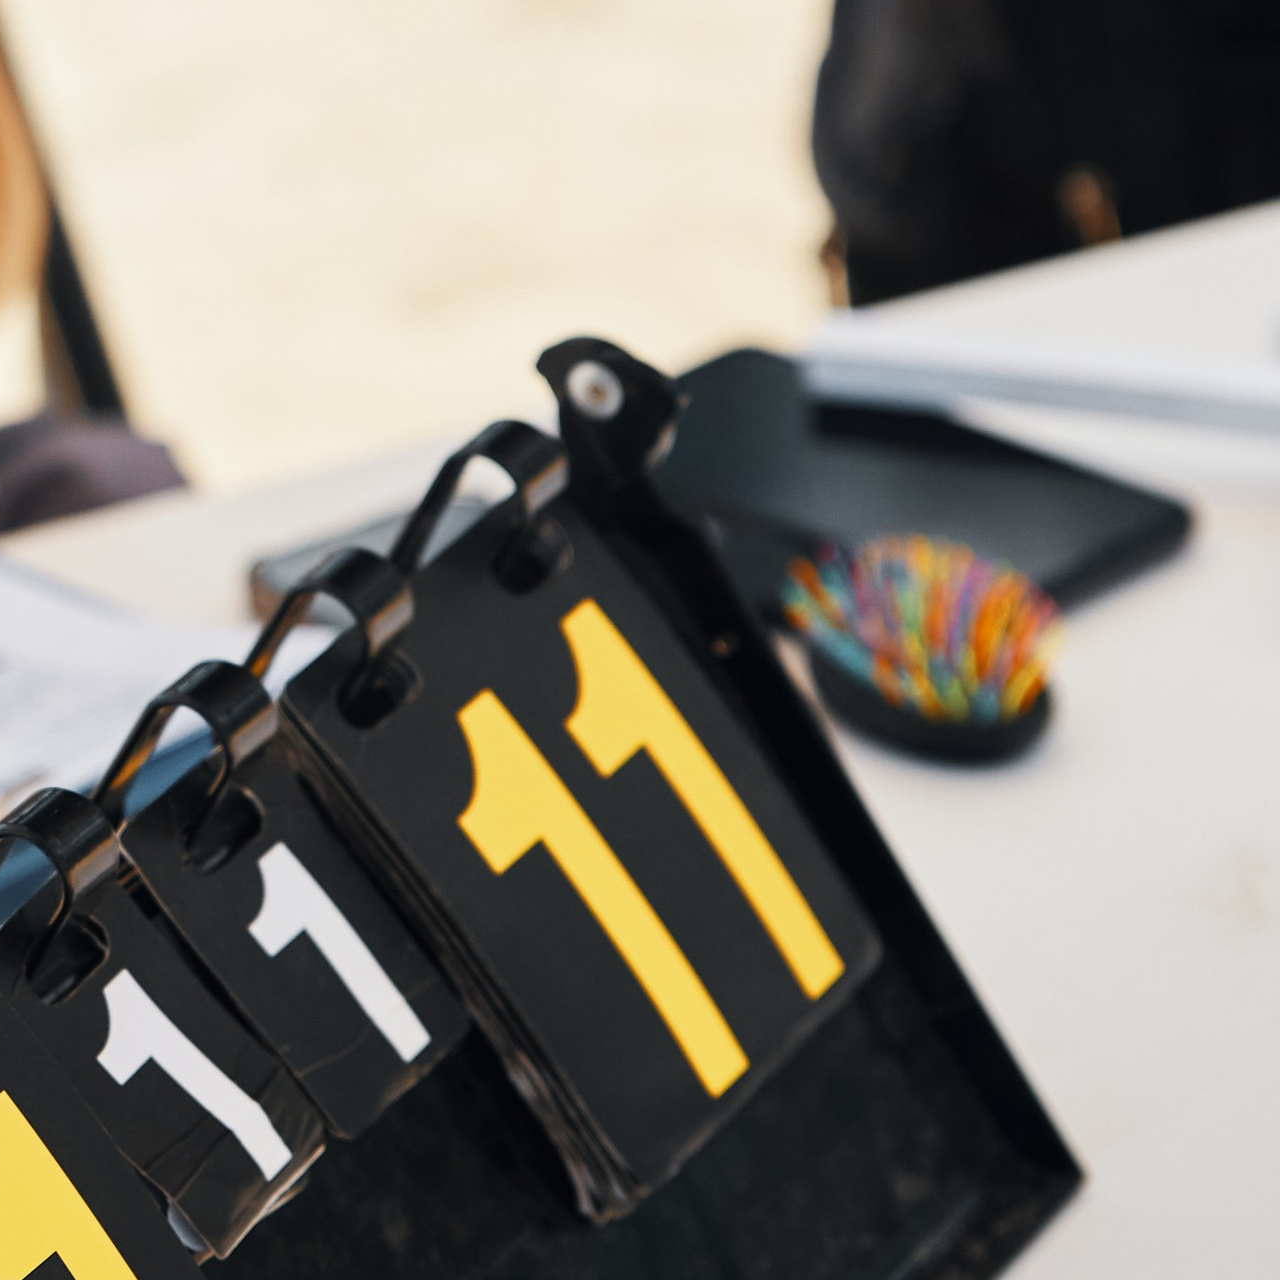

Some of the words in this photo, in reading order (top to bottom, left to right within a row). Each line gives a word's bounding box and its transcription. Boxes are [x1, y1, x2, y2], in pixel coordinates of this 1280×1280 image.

[96, 967, 294, 1182] 1
[247, 841, 432, 1063] 1
[458, 599, 845, 1098] 11
